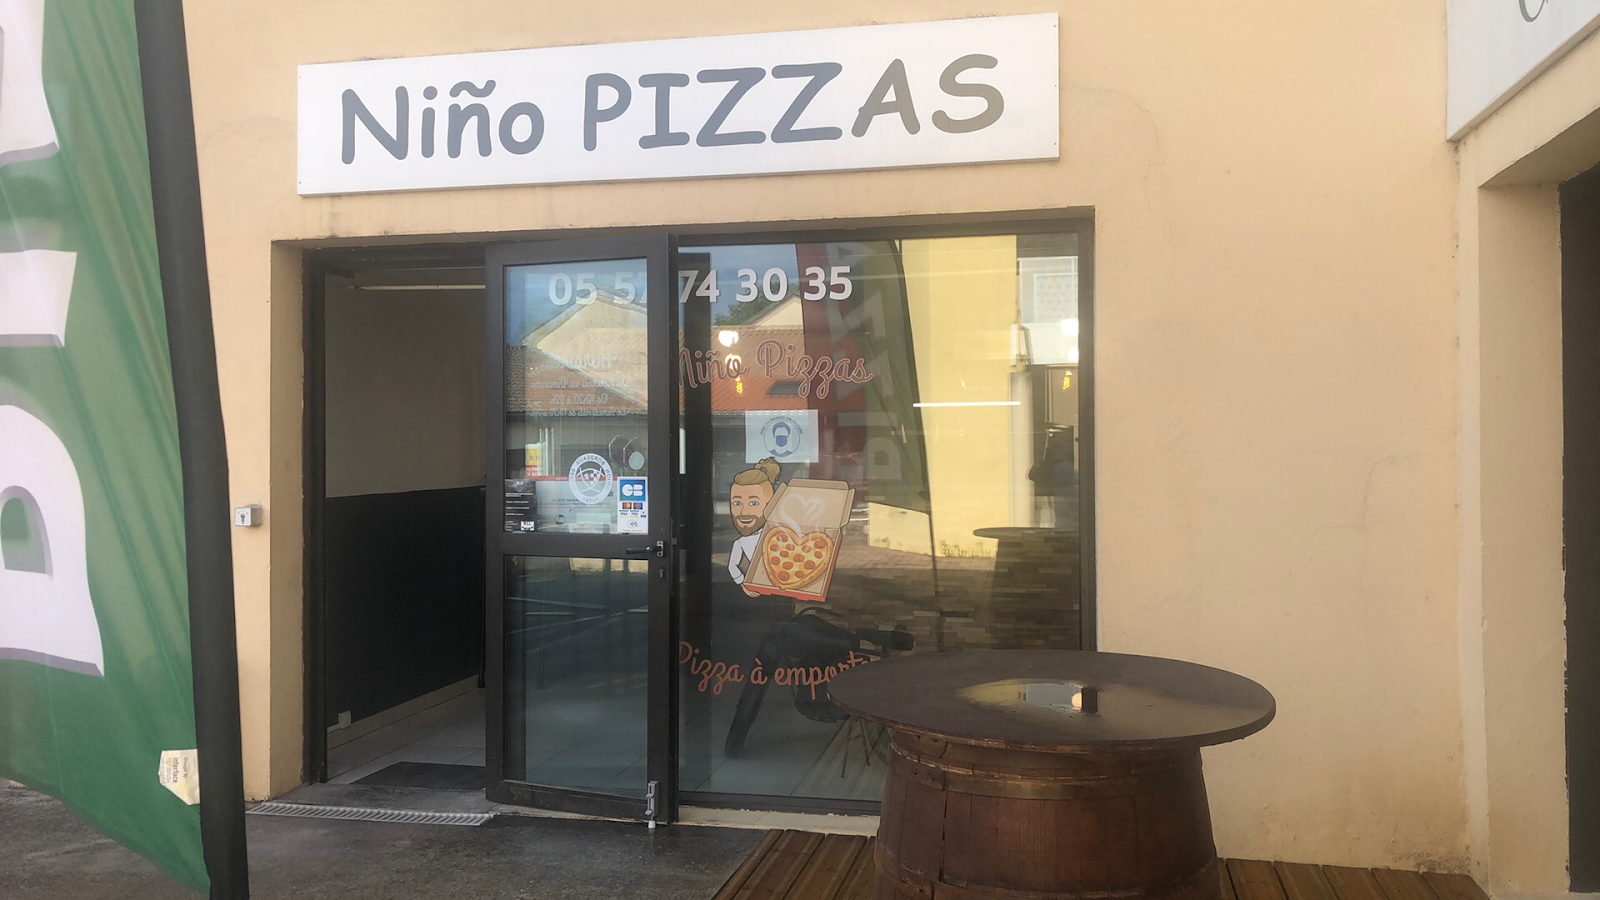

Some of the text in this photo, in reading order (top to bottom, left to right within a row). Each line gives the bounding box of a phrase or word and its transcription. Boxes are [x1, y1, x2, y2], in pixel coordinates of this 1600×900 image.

[341, 53, 1005, 165] Niño PIZZAS
[548, 272, 598, 307] 05
[679, 269, 721, 303] 74
[735, 267, 788, 302] 30
[803, 265, 853, 301] 35
[679, 338, 874, 400] Niño Pizzas
[621, 484, 643, 497] CB
[750, 658, 767, 685] à
